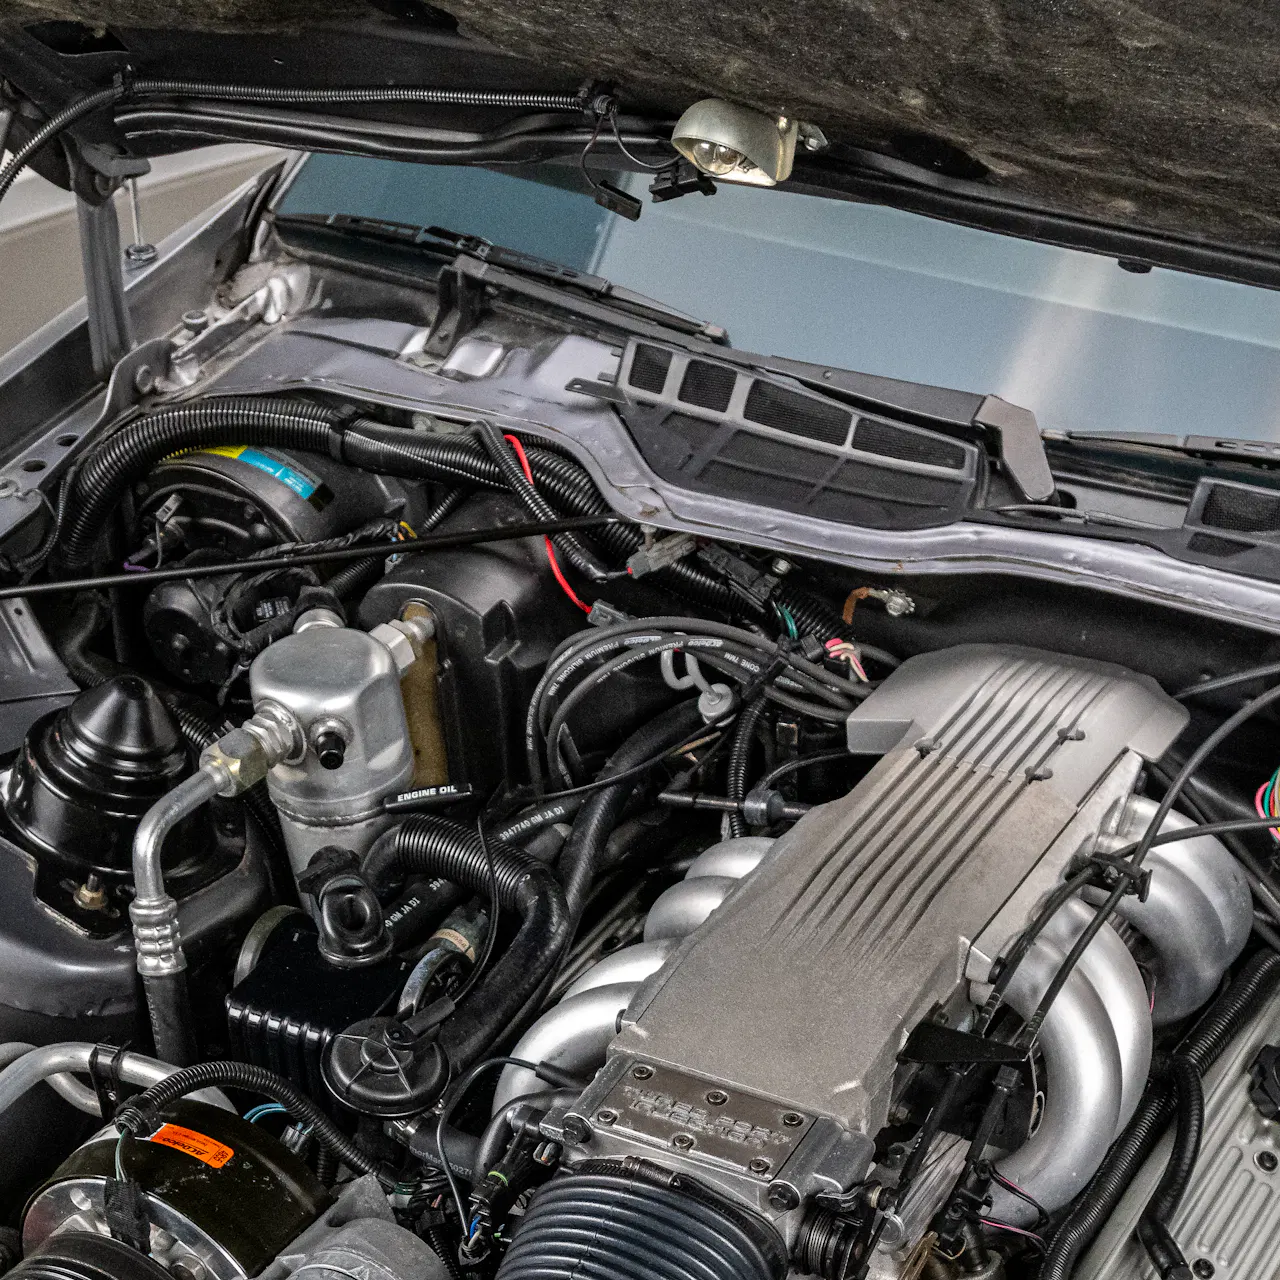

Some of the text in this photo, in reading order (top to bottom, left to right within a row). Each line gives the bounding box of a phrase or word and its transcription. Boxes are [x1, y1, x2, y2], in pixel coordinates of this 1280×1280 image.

[584, 641, 620, 660] PREMIUM
[556, 658, 585, 683] SILICONE
[723, 651, 761, 672] CONE 7MM
[397, 784, 458, 802] ENGINE OIL
[530, 813, 544, 825] GM
[390, 911, 404, 922] GM
[400, 904, 413, 915] JA
[162, 1137, 207, 1156] ACDelco
